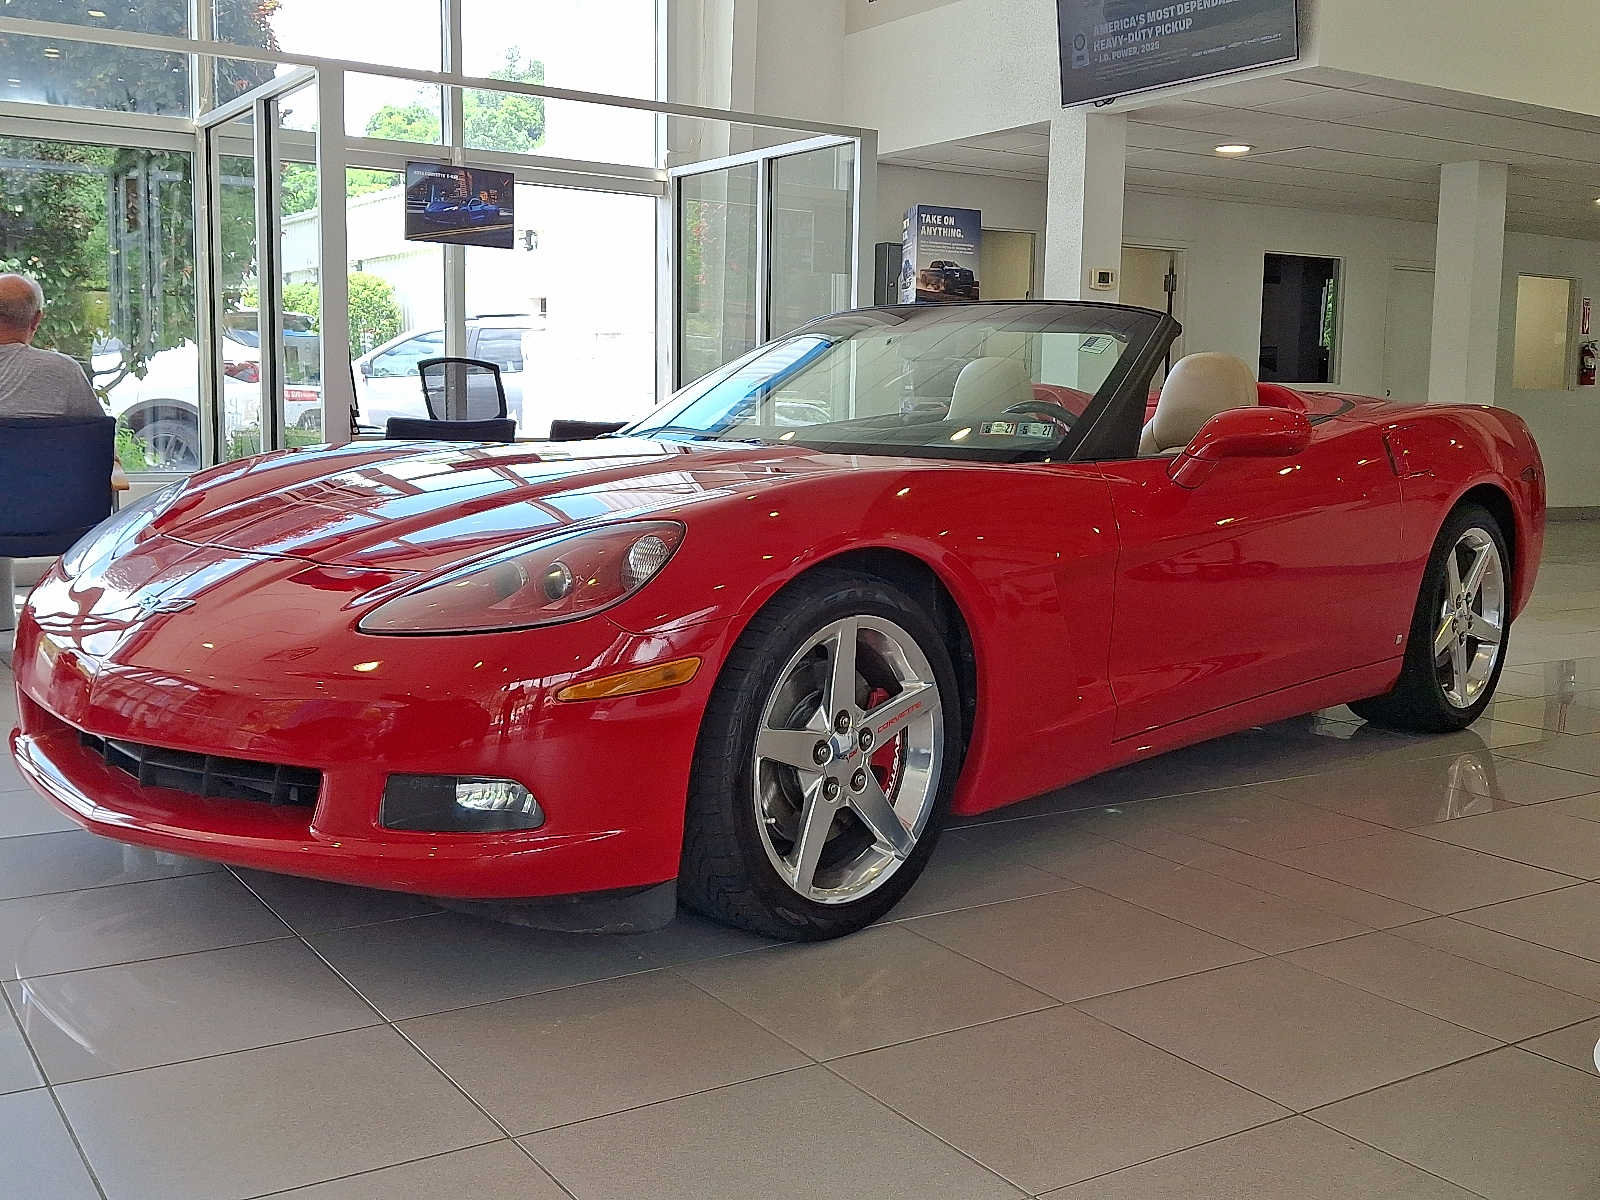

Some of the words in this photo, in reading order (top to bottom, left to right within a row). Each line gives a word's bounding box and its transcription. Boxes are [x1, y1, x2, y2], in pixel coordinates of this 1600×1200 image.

[1094, 14, 1145, 36] AMERICA'S
[1147, 5, 1175, 24] MOST
[1094, 27, 1153, 52] HEAVY-DUTY
[1156, 18, 1193, 37] PICKUP
[920, 213, 942, 225] TAKE
[943, 215, 955, 226] ON
[920, 226, 964, 238] ANYTHING.
[1005, 423, 1015, 433] 27
[1042, 425, 1052, 437] 27
